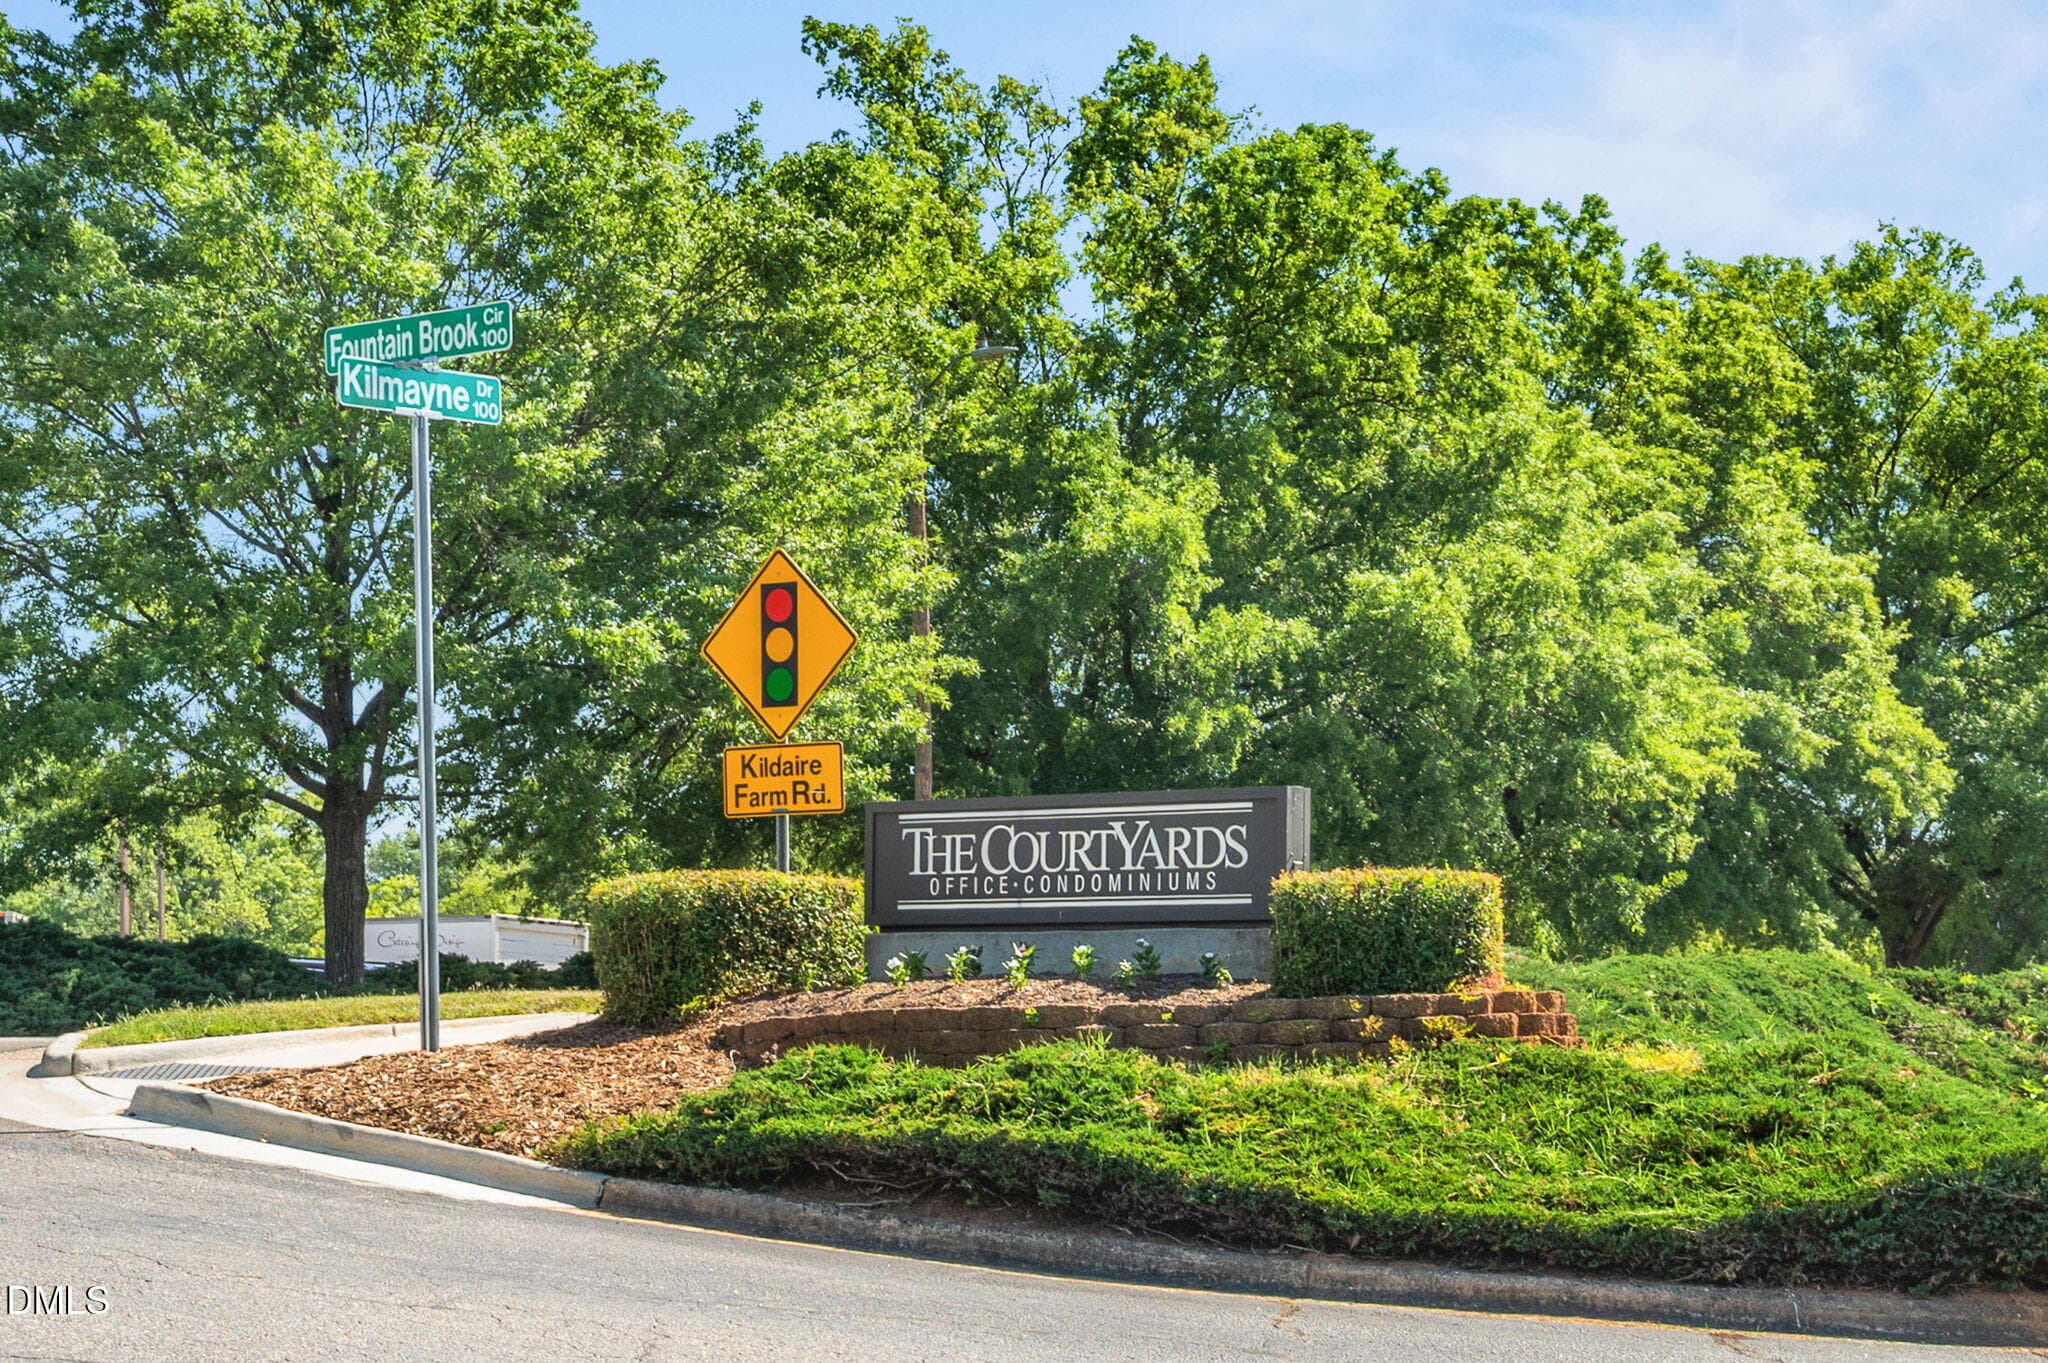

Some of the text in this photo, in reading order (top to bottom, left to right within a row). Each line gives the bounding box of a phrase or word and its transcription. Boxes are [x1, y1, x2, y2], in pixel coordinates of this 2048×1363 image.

[330, 307, 504, 367] Fountain Brook Cir
[481, 327, 508, 348] 100
[343, 362, 494, 413] Kilmayne Dr
[472, 400, 499, 420] 100
[741, 754, 822, 779] Kildaire
[734, 780, 831, 808] Farm Rd.
